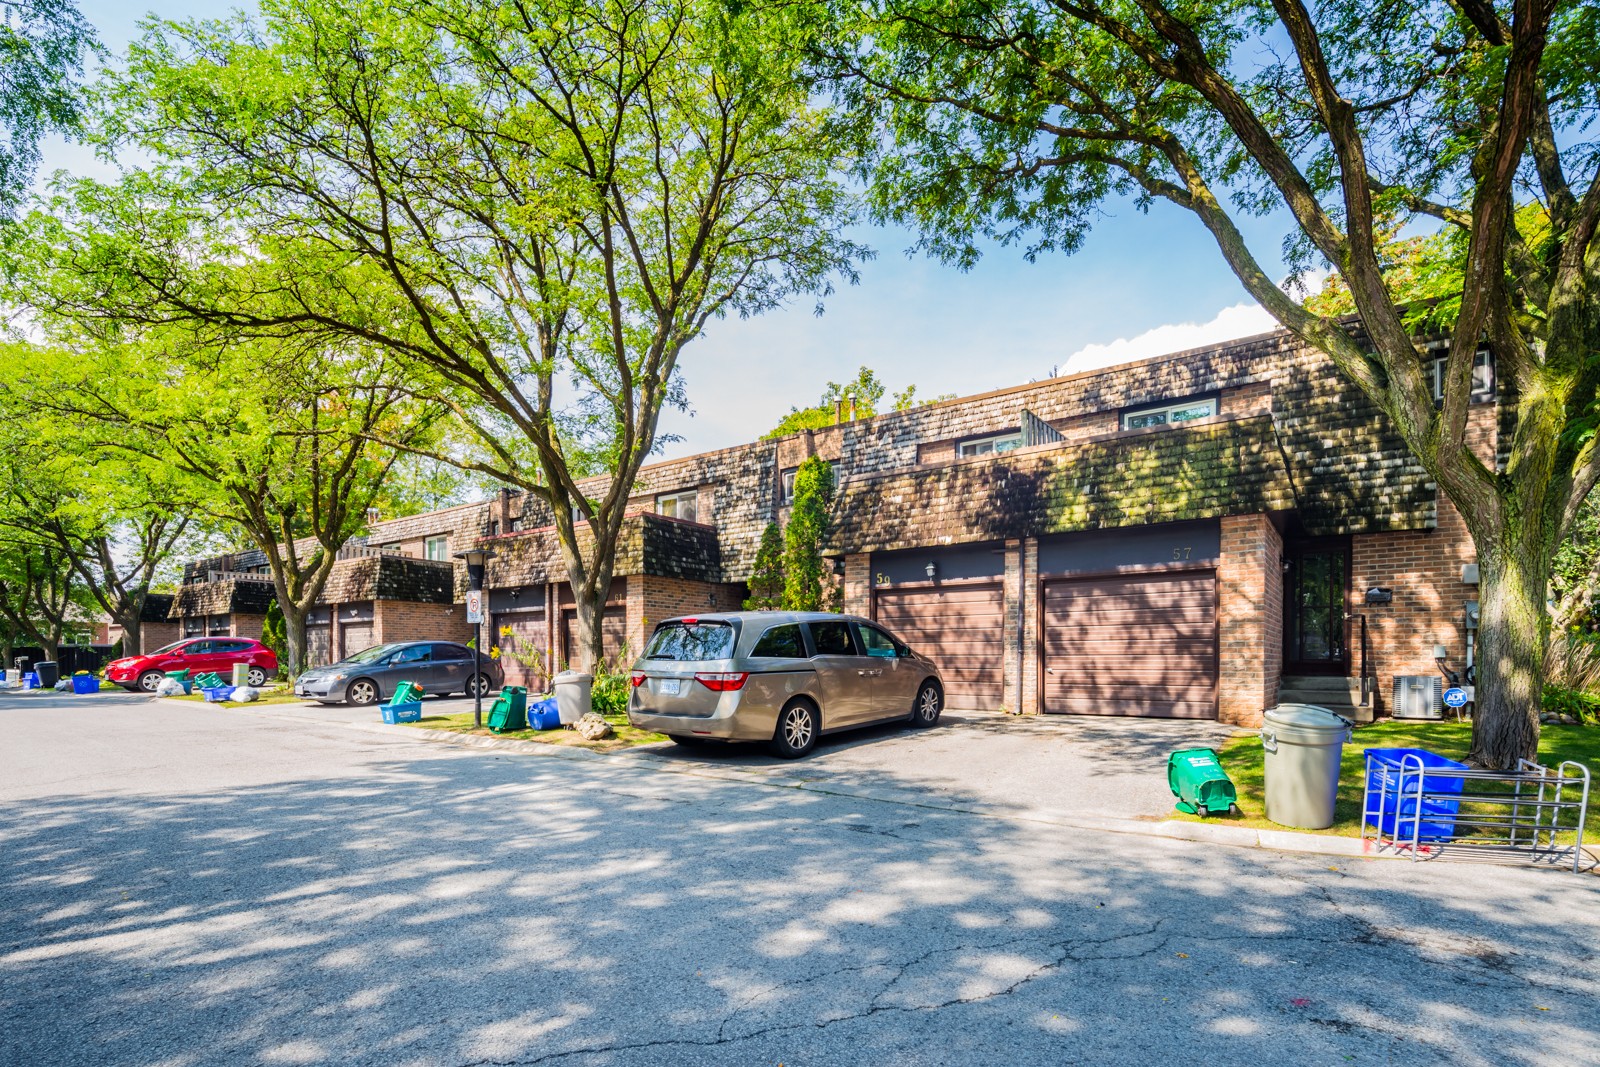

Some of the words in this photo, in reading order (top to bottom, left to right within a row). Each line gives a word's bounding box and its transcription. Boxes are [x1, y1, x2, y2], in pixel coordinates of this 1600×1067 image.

[1173, 547, 1192, 560] 57
[876, 572, 891, 586] 59
[1446, 692, 1465, 701] ADT
